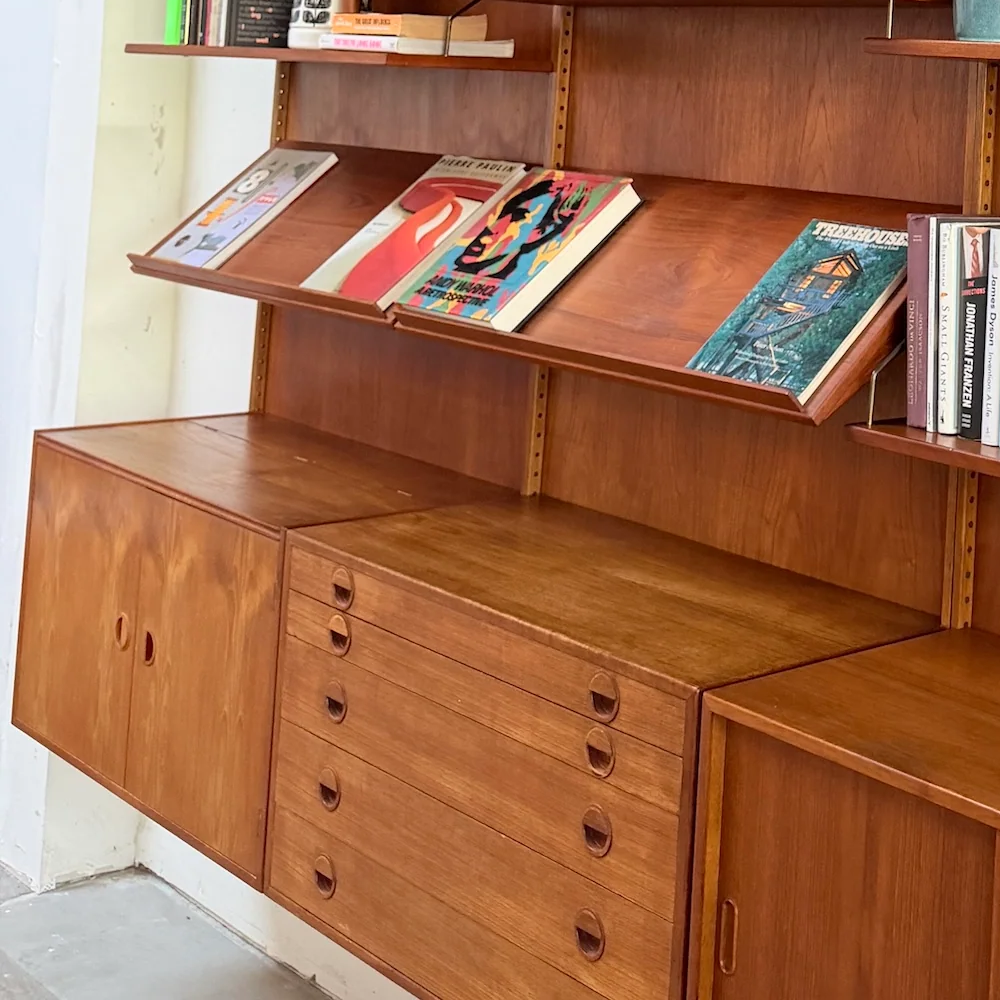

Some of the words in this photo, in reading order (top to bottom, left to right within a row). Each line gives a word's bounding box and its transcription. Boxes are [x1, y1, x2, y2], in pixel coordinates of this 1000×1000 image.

[439, 159, 475, 168] PIERRE
[475, 162, 517, 173] PAULIN
[425, 275, 456, 289] ANDY
[454, 280, 500, 297] WARHOL
[990, 275, 998, 310] James
[941, 306, 950, 347] SMALL
[965, 302, 976, 356] JONATHAN
[988, 312, 997, 346] Dyson
[940, 352, 950, 402] GIANTS
[961, 358, 974, 408] FRANZEN
